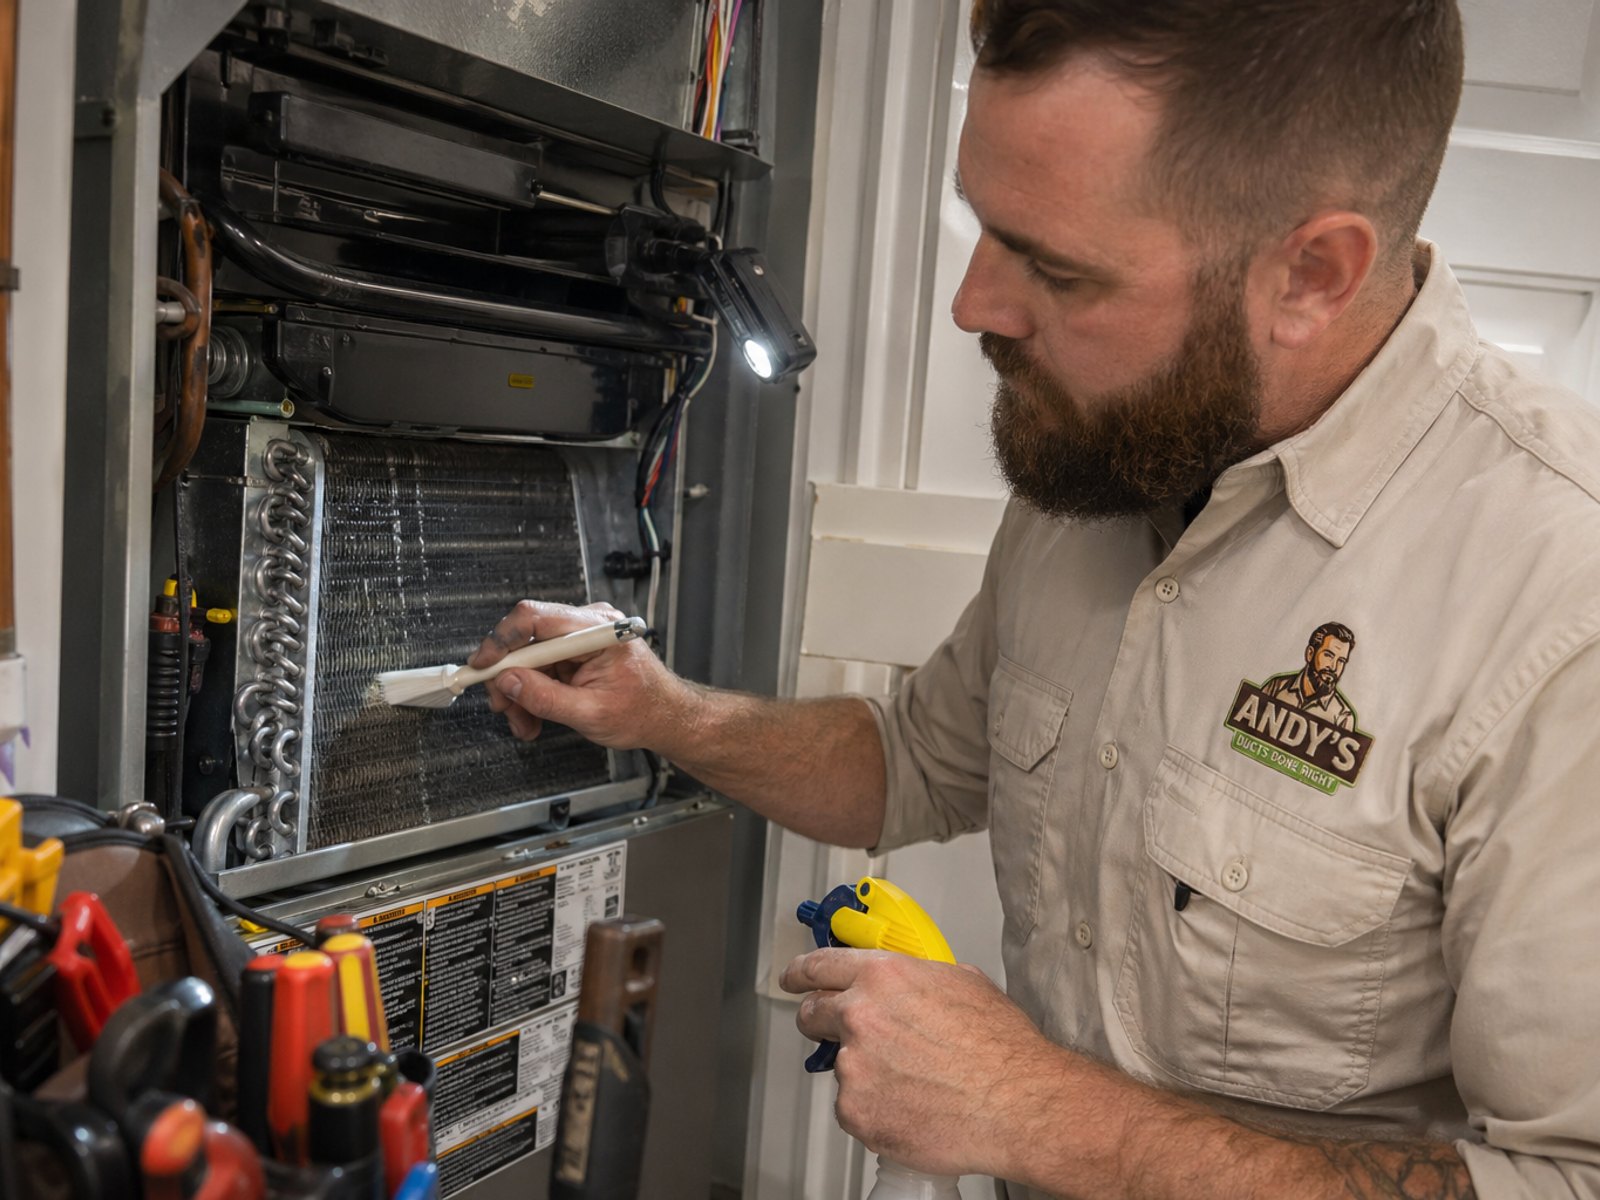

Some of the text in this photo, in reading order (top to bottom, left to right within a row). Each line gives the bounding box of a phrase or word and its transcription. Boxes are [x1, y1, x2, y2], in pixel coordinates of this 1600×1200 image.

[1234, 694, 1361, 772] ANDY'S
[1236, 734, 1270, 758] DUCTS
[1300, 764, 1335, 789] RIGHT
